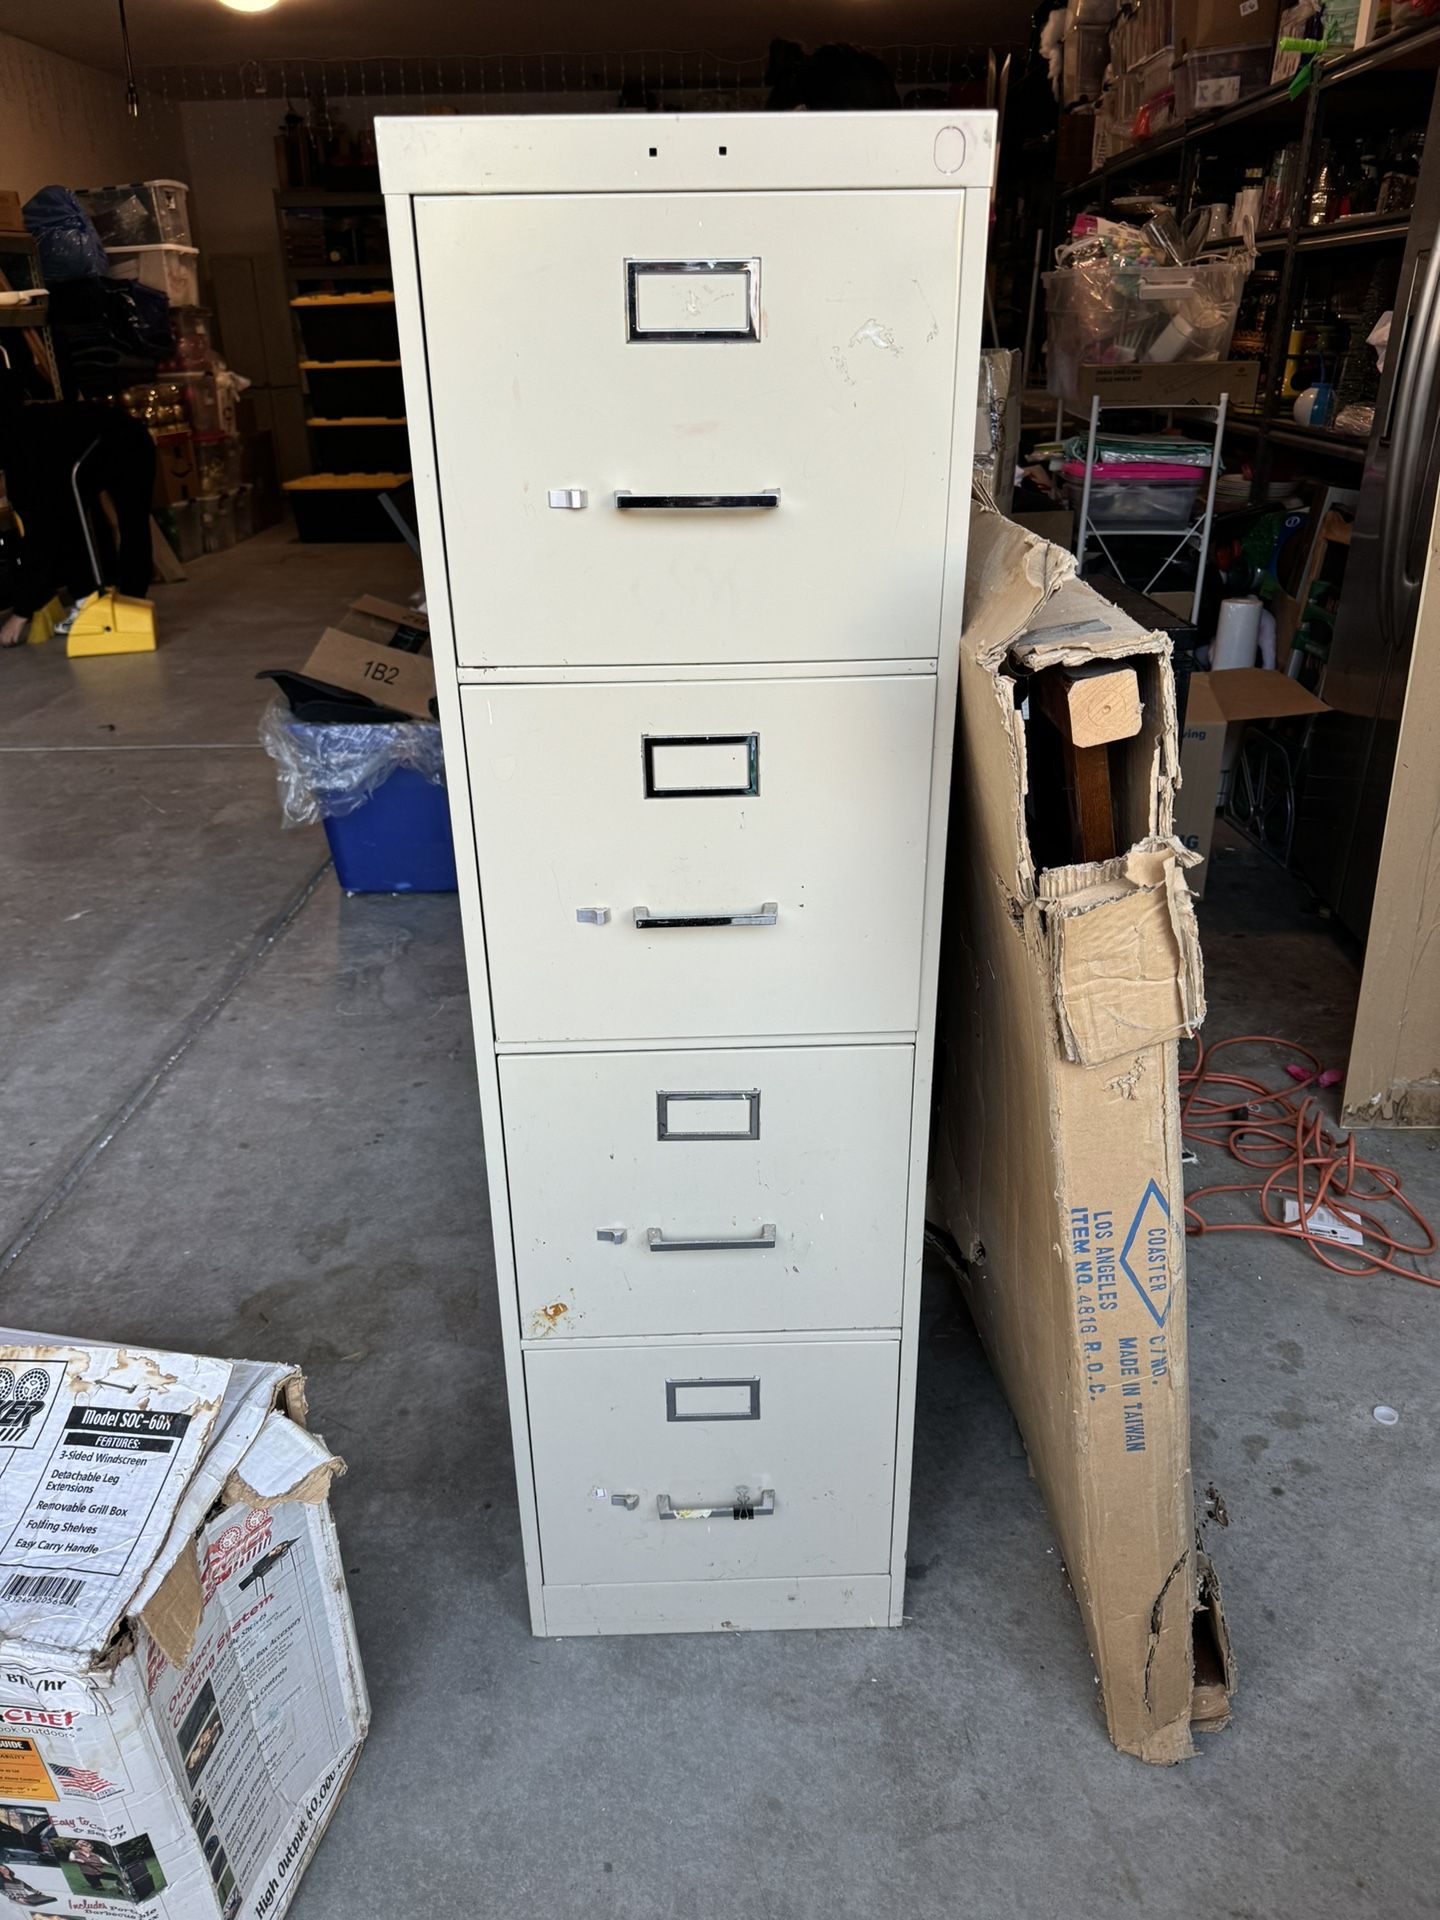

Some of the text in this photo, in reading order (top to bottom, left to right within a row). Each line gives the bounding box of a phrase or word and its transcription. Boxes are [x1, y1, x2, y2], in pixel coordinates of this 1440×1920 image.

[364, 661, 400, 686] 1B2
[1071, 1207, 1091, 1255] ITEM
[1093, 1210, 1118, 1311] LOS ANGELES
[1147, 1228, 1167, 1293] COASTER
[1118, 1336, 1147, 1453] MADE IN TAIWAN
[82, 1408, 119, 1428] Model
[94, 1435, 141, 1450] FEATURES:
[59, 1450, 148, 1466] 3-Sided Windscreen
[45, 1481, 95, 1494] Extensions
[50, 1469, 120, 1486] Detachable Leg
[35, 1500, 128, 1517] Removable Grill Box
[25, 1519, 98, 1534] Folding Shelves
[14, 1538, 100, 1555] Easy Carry Handle
[173, 1653, 215, 1729] Cooking
[217, 1593, 274, 1656] System
[169, 1632, 215, 1714] Outdoor
[254, 1878, 280, 1920] High
[276, 1818, 310, 1879] Output
